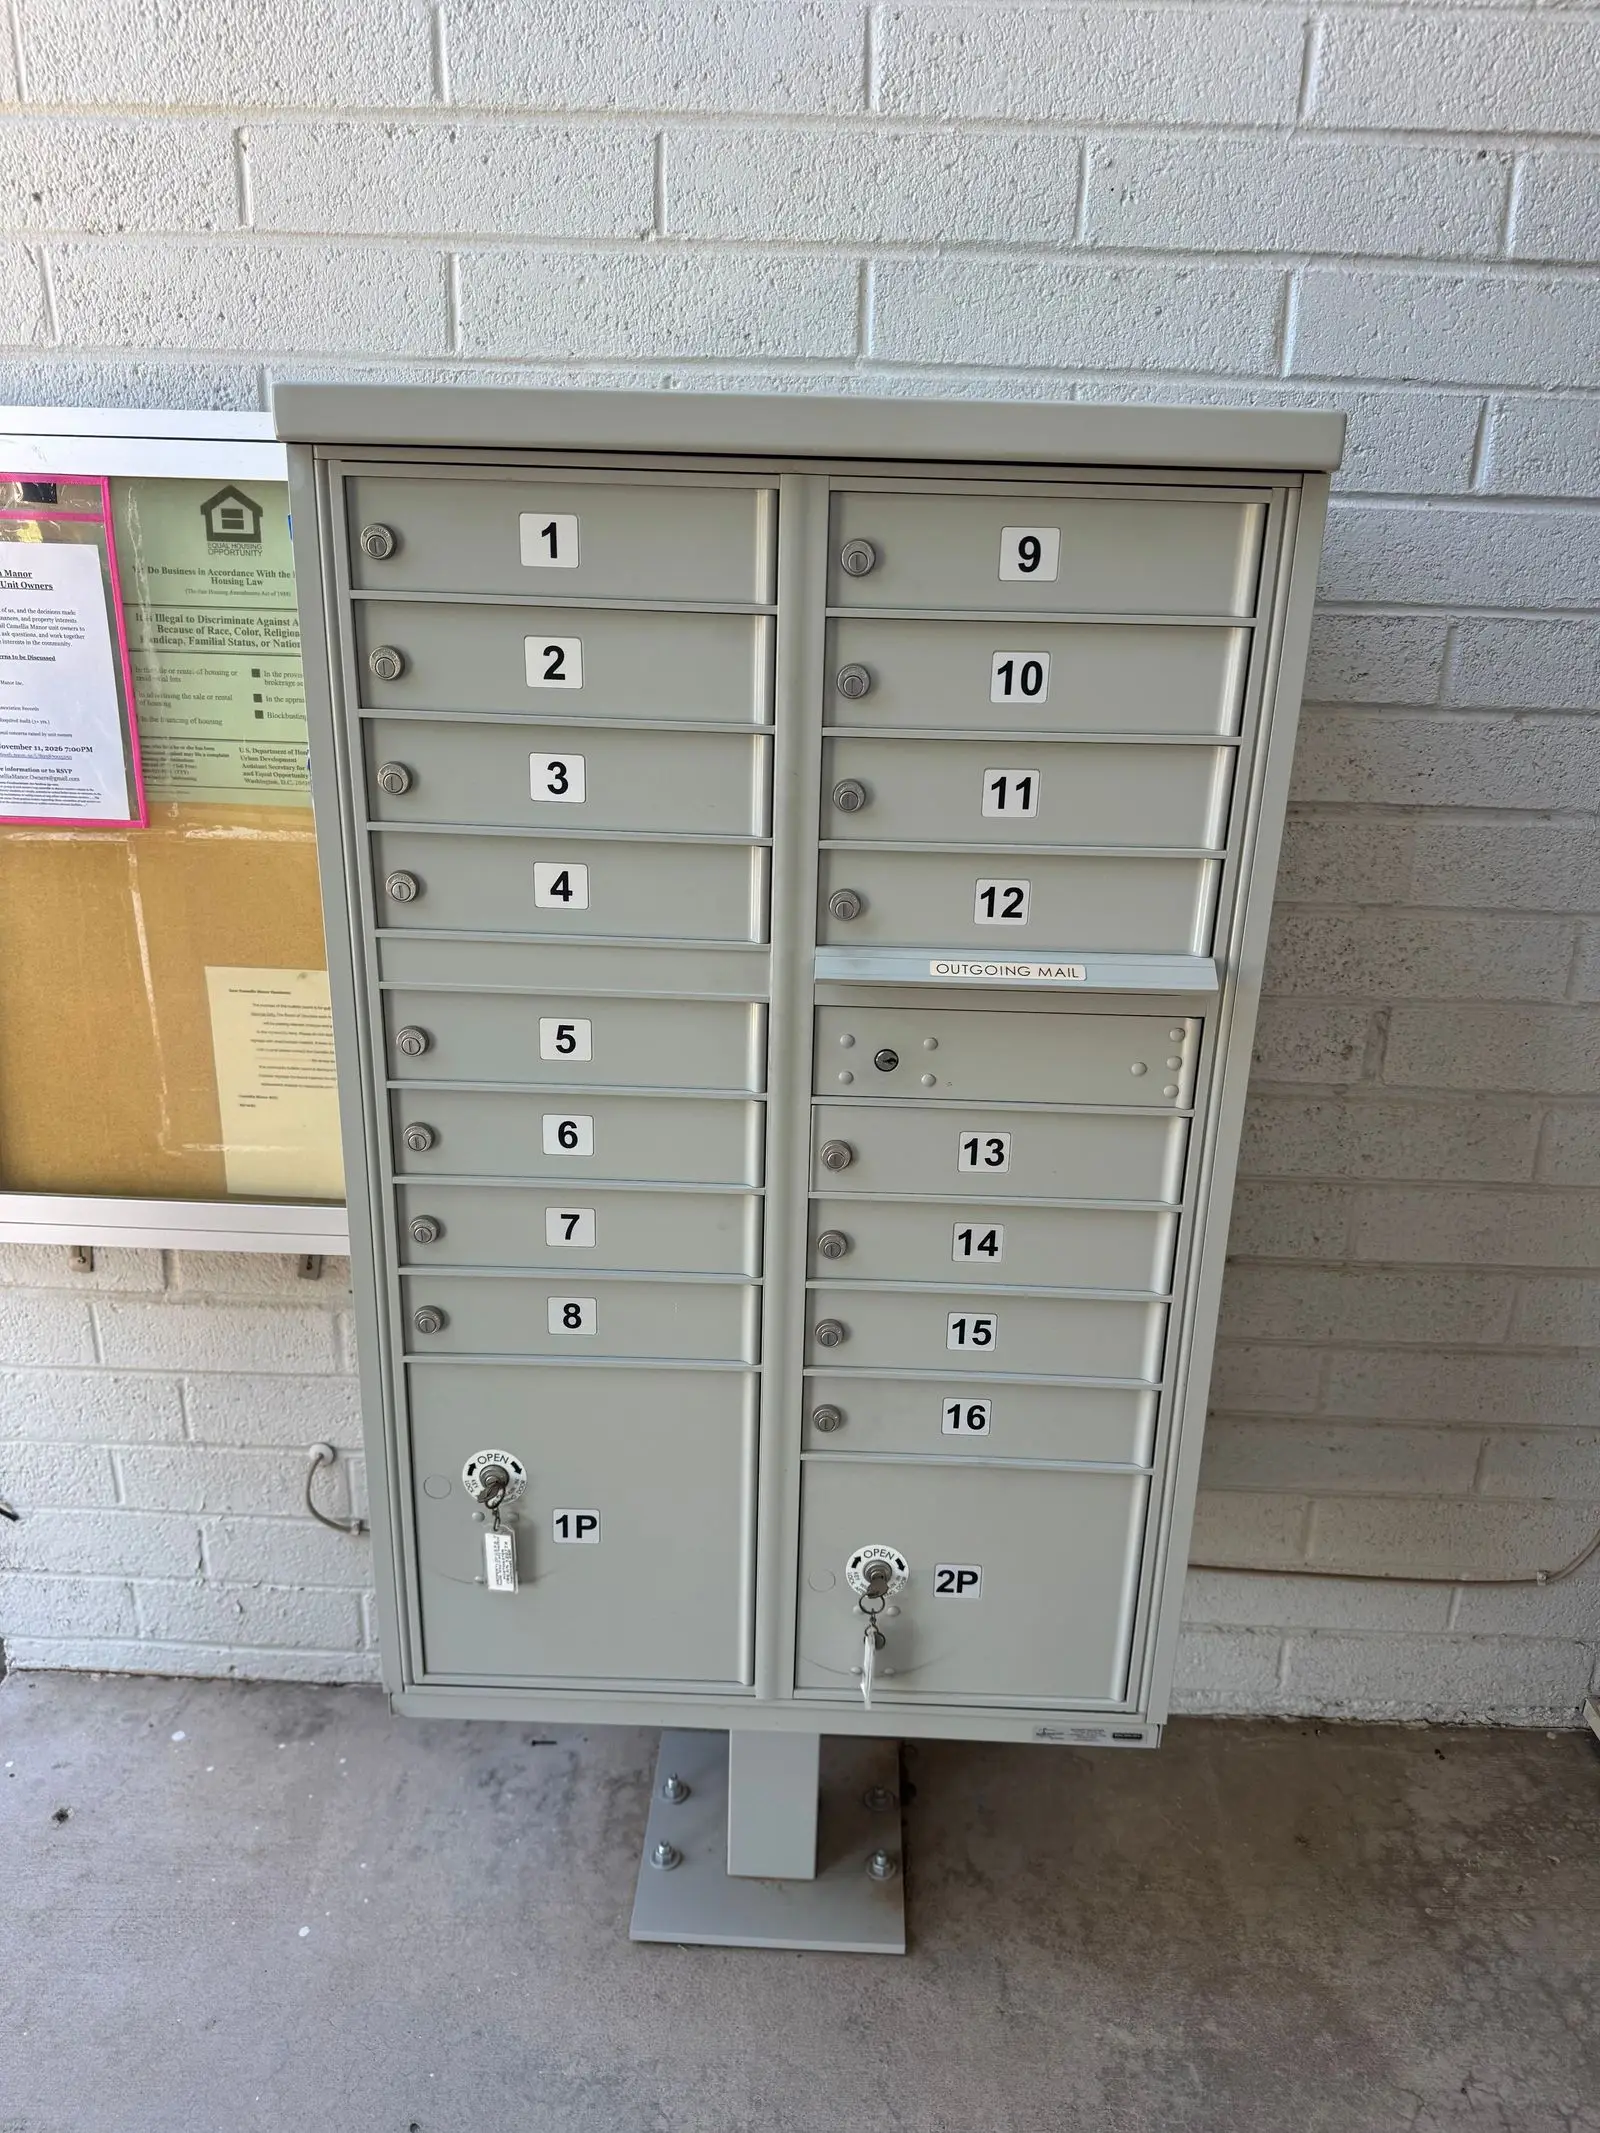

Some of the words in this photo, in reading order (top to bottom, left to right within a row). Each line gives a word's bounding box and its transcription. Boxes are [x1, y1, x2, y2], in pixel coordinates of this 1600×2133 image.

[207, 542, 230, 550] EQUAL
[231, 543, 262, 551] HOUSING
[541, 521, 558, 559] 1
[1017, 535, 1042, 573] 9
[1, 581, 22, 589] Unit
[21, 582, 53, 591] Owners
[4, 569, 32, 579] Manor
[148, 566, 159, 574] Do
[161, 567, 196, 575] Business
[208, 569, 254, 579] Accordance
[256, 570, 276, 578] With
[211, 577, 244, 586] Housing
[135, 612, 143, 622] It
[155, 613, 183, 625] Illegal
[198, 615, 254, 625] Discriminate
[257, 617, 290, 629] Against
[157, 624, 193, 634] Because
[196, 626, 205, 634] of
[206, 626, 232, 636] Race,
[234, 627, 261, 637] Color,
[188, 636, 226, 646] Familial
[228, 638, 258, 647] Status,
[543, 645, 566, 681] 2
[997, 660, 1043, 696] 10
[252, 748, 287, 758] Department
[260, 756, 297, 766] Development
[547, 761, 569, 795] 3
[991, 776, 1032, 810] 11
[550, 870, 573, 902] 4
[980, 886, 1024, 919] 12
[936, 963, 1031, 977] OUTGOING
[1038, 966, 1079, 979] MAIL
[555, 1024, 577, 1054] 5
[557, 1120, 578, 1149] 6
[964, 1137, 1005, 1167] 13
[560, 1213, 580, 1241] 7
[958, 1228, 999, 1257] 14
[562, 1302, 582, 1329] 8
[952, 1318, 992, 1346] 15
[947, 1403, 986, 1431] 16
[477, 1453, 510, 1465] OPEN
[555, 1514, 598, 1539] 1P
[863, 1548, 895, 1561] OPEN
[935, 1569, 979, 1594] 2P
